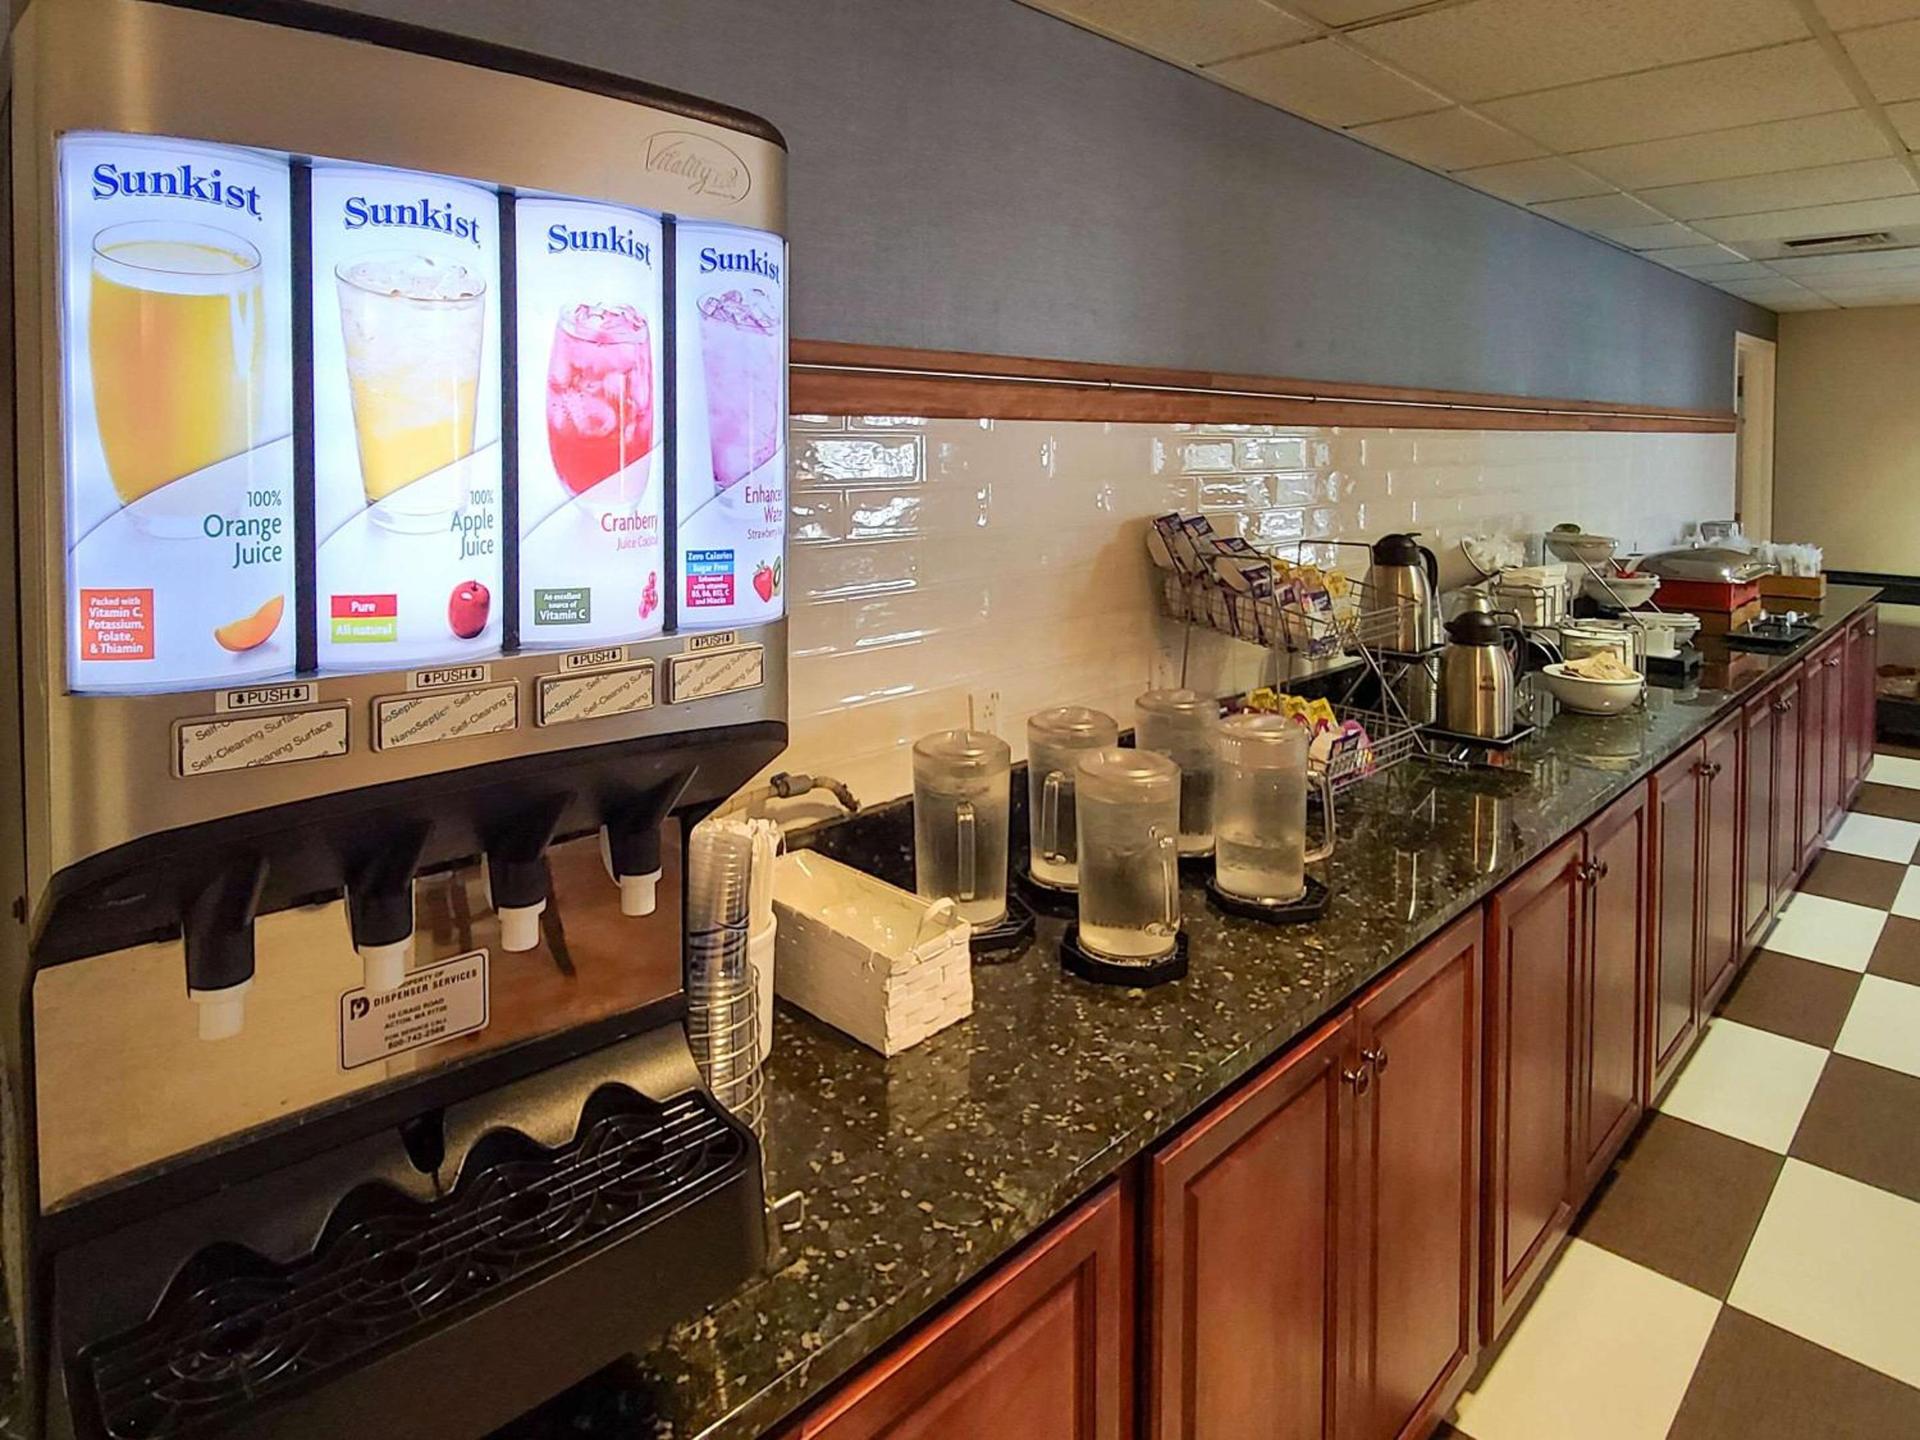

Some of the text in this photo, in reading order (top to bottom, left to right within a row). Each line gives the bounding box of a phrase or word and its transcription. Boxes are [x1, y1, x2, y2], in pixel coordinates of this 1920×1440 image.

[92, 163, 262, 216] Sunkist
[345, 197, 480, 244] Sunkist
[548, 224, 652, 267] Sunkist
[700, 248, 780, 283] Sunkist
[246, 490, 282, 507] 100%
[470, 489, 494, 505] 100%
[204, 514, 282, 541] Orange
[450, 508, 494, 538] Apple
[232, 541, 282, 569] Juice
[459, 536, 494, 560] Juice
[89, 607, 130, 617] Vitamin
[351, 601, 376, 612] Pure
[539, 609, 586, 620] Vitamin C
[88, 619, 145, 630] Potassium,
[98, 631, 135, 642] Folate,
[700, 637, 725, 647] PUSH
[101, 643, 143, 653] Thiamin
[580, 652, 609, 665] PUSH
[433, 670, 468, 683] PUSH
[248, 688, 290, 704] PUSH
[293, 721, 333, 746] Surface
[191, 730, 264, 771] Self-Cleaning
[374, 984, 428, 1007] DISPENSER
[432, 969, 477, 989] SERVICES
